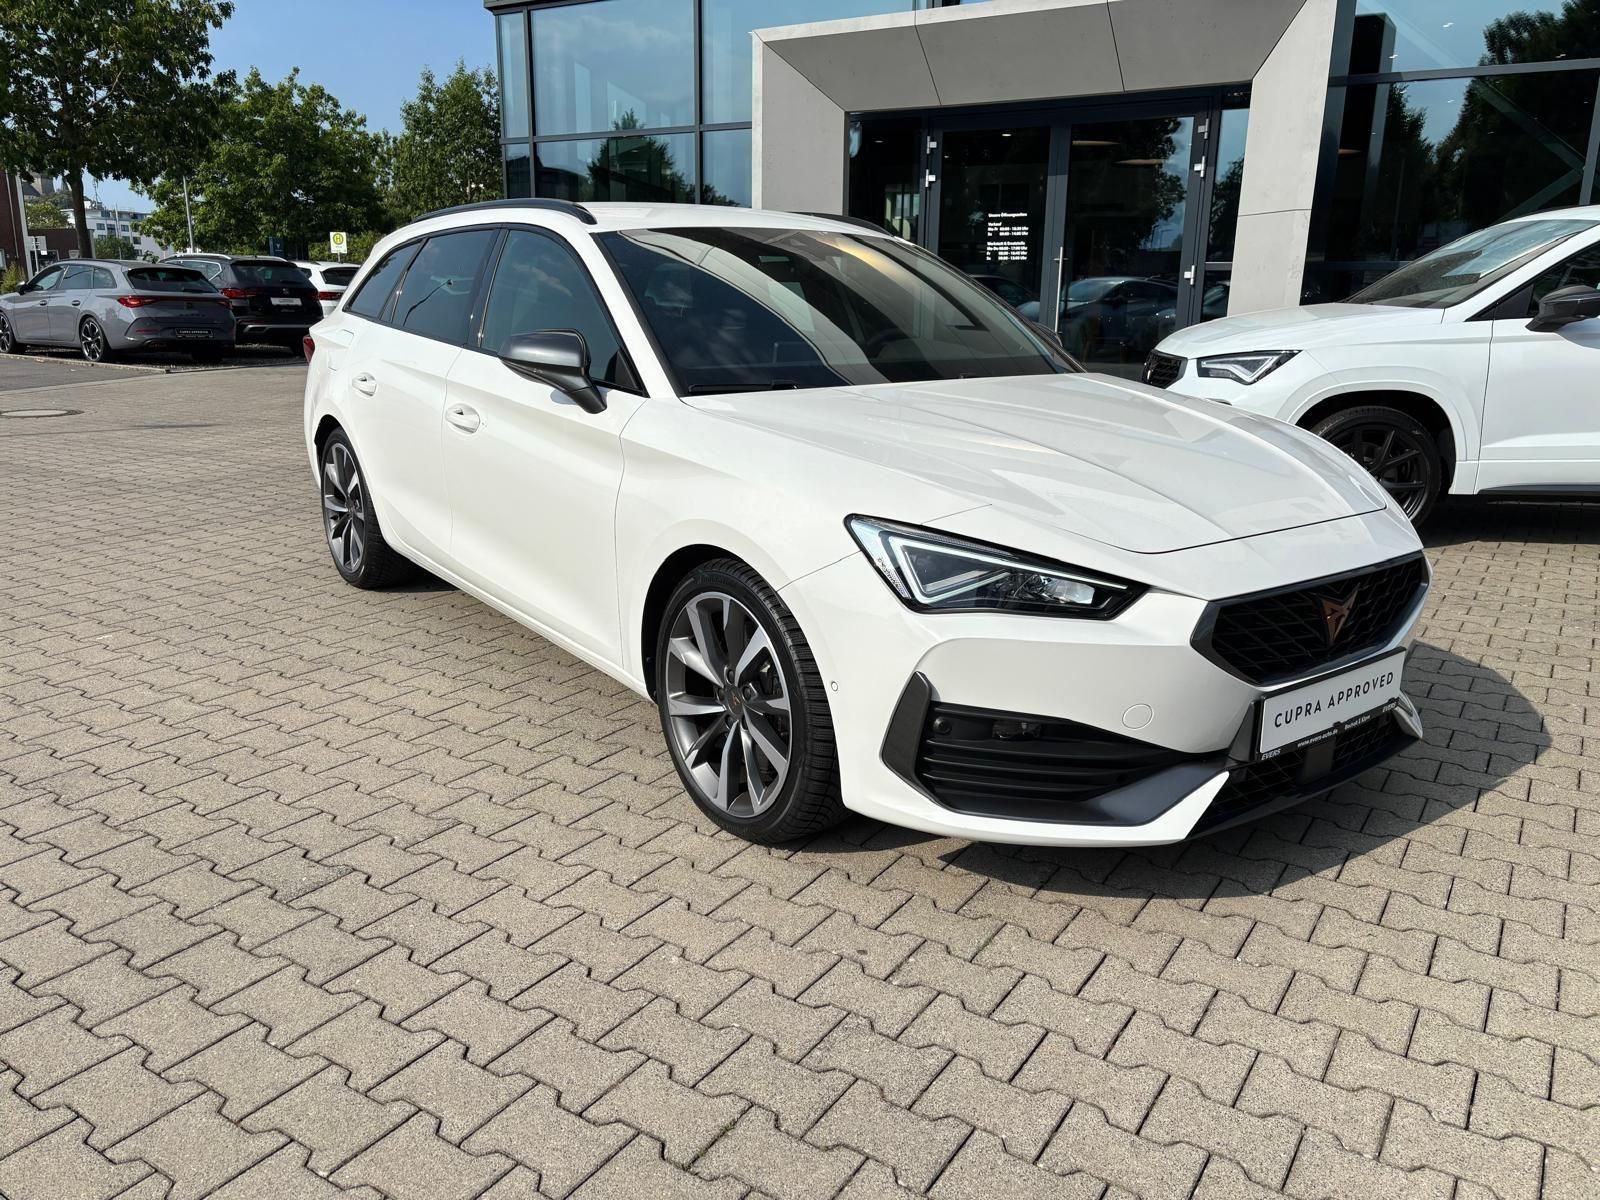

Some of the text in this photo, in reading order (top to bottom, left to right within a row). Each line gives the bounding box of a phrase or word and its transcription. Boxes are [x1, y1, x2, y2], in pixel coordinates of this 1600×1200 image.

[1274, 672, 1394, 728] CUPRA APPROVED
[1261, 748, 1282, 760] EVERS
